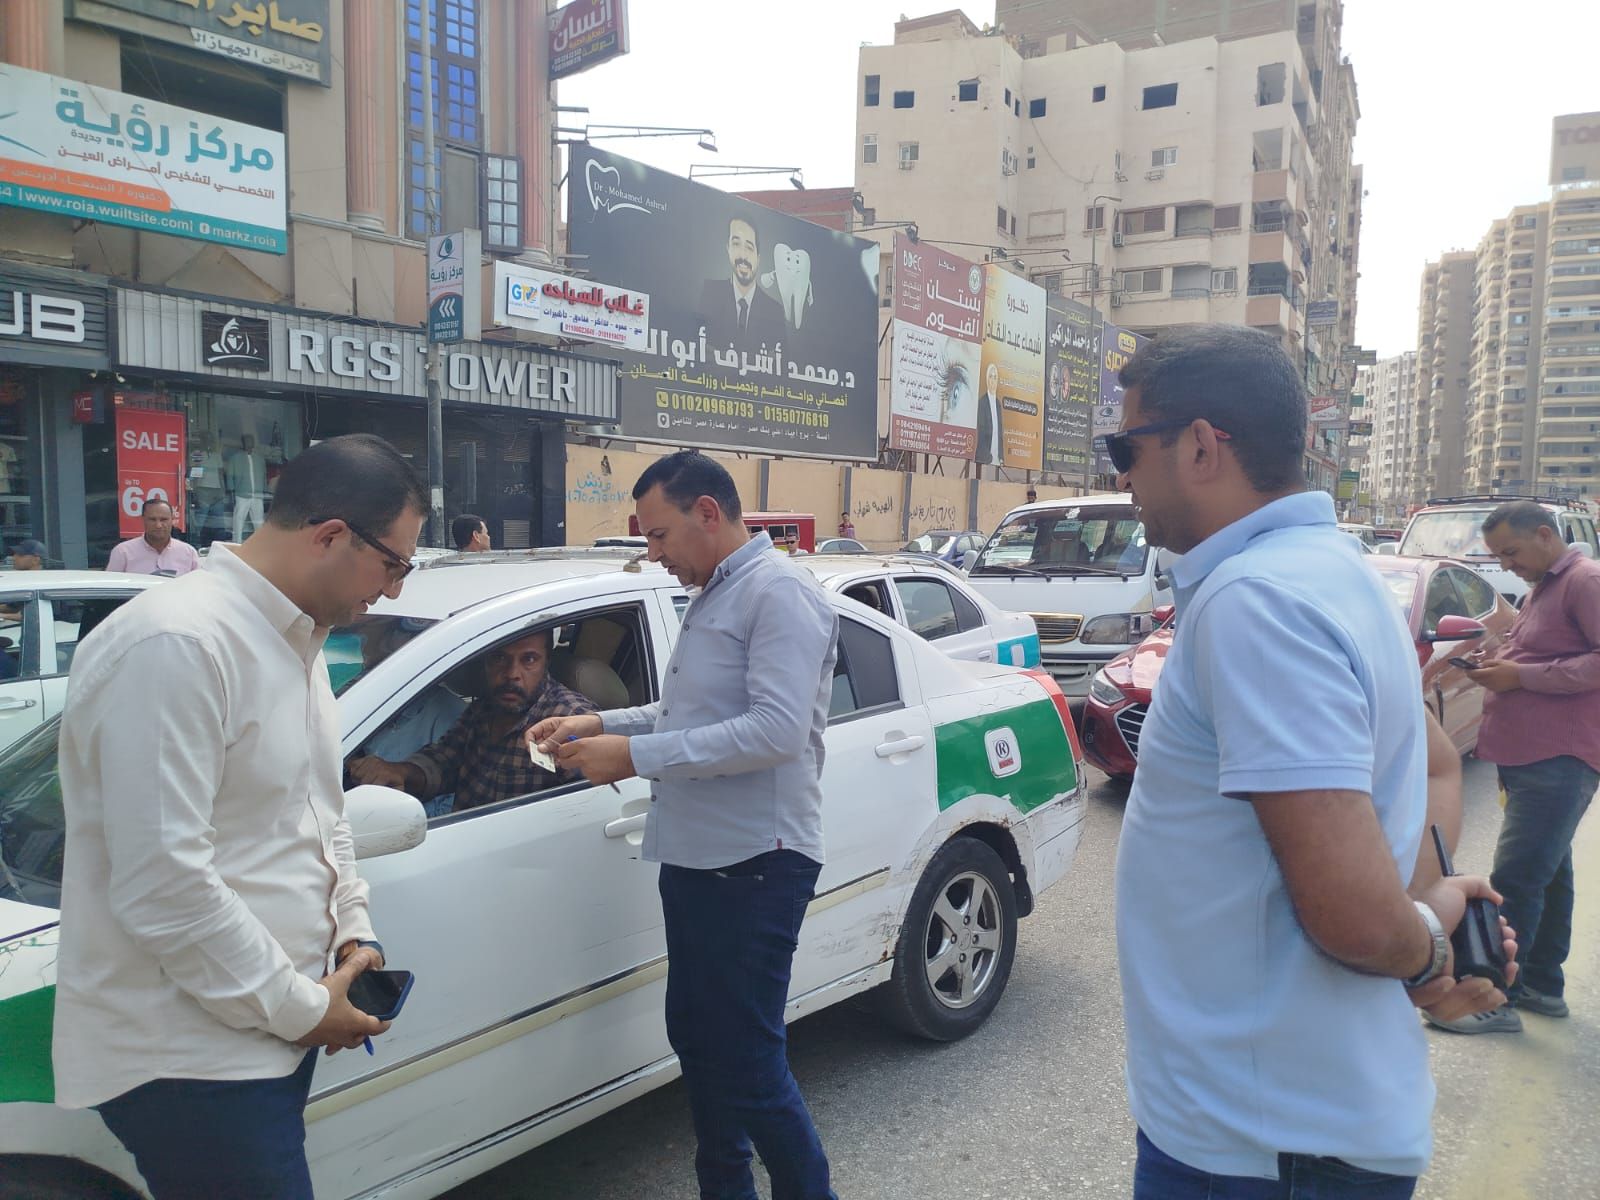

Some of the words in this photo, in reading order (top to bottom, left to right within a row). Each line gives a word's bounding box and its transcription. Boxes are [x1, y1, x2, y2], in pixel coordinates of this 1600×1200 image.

[218, 0, 323, 42] صابر
[56, 87, 170, 156] رؤية
[71, 128, 102, 145] جديدة
[185, 120, 274, 173] مركز
[58, 145, 104, 163] العين
[108, 156, 161, 175] أمراض
[164, 161, 211, 187] لتشخيص
[214, 177, 275, 200] التخصصي
[609, 185, 643, 204] Mohamed
[212, 226, 277, 248] markz.roia
[926, 279, 981, 317] بستان
[1007, 293, 1029, 314] دكتورة
[926, 312, 980, 337] الفيوم
[983, 319, 1006, 343] القادر
[1007, 330, 1020, 350] عبد
[1022, 332, 1041, 356] شيماء
[289, 328, 400, 382] RGS
[713, 342, 782, 377] أشرف
[681, 370, 718, 391] وزراعة
[720, 375, 759, 397] وتجميل
[760, 384, 785, 398] الفم
[786, 388, 814, 405] جراحة
[672, 393, 754, 418] 01020968793
[764, 405, 830, 428] 01550776819
[123, 430, 179, 452] SALE
